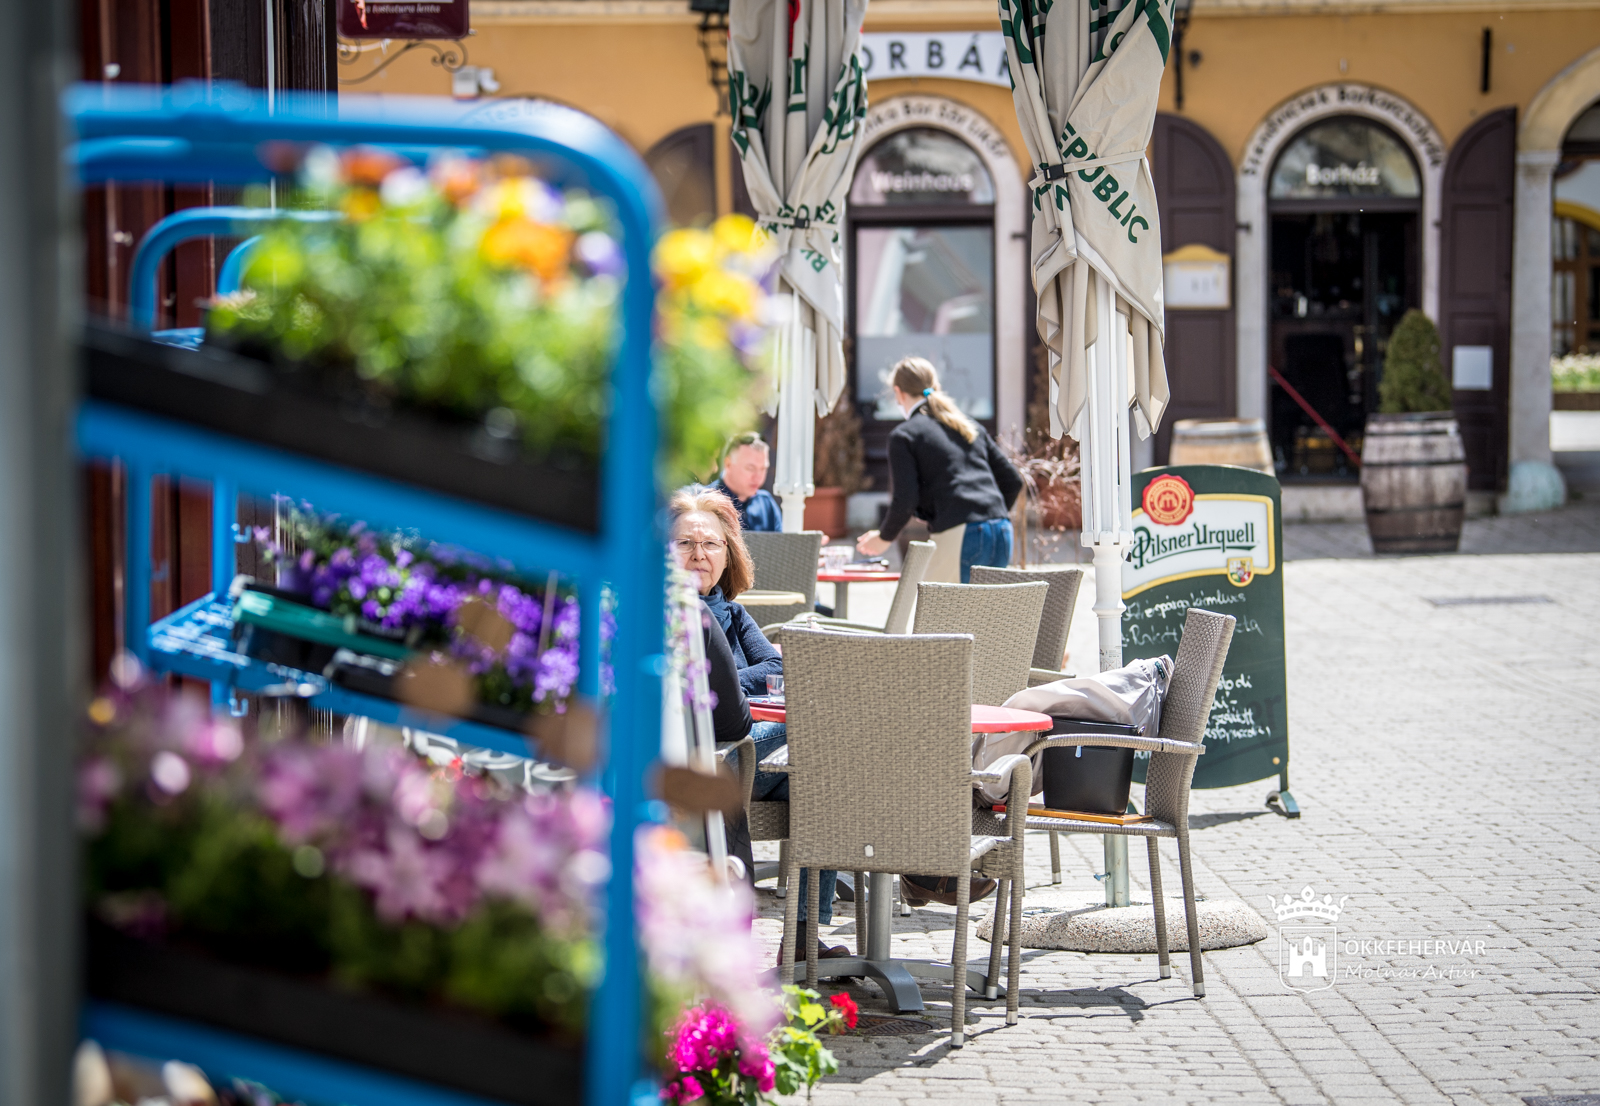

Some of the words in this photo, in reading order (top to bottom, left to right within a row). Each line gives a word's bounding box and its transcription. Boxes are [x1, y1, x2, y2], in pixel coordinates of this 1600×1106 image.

[416, 3, 441, 14] lenta
[871, 170, 974, 192] Weinhaus
[1306, 161, 1379, 185] Borház
[1132, 526, 1194, 570] Pilsner
[1193, 522, 1255, 553] Urquell
